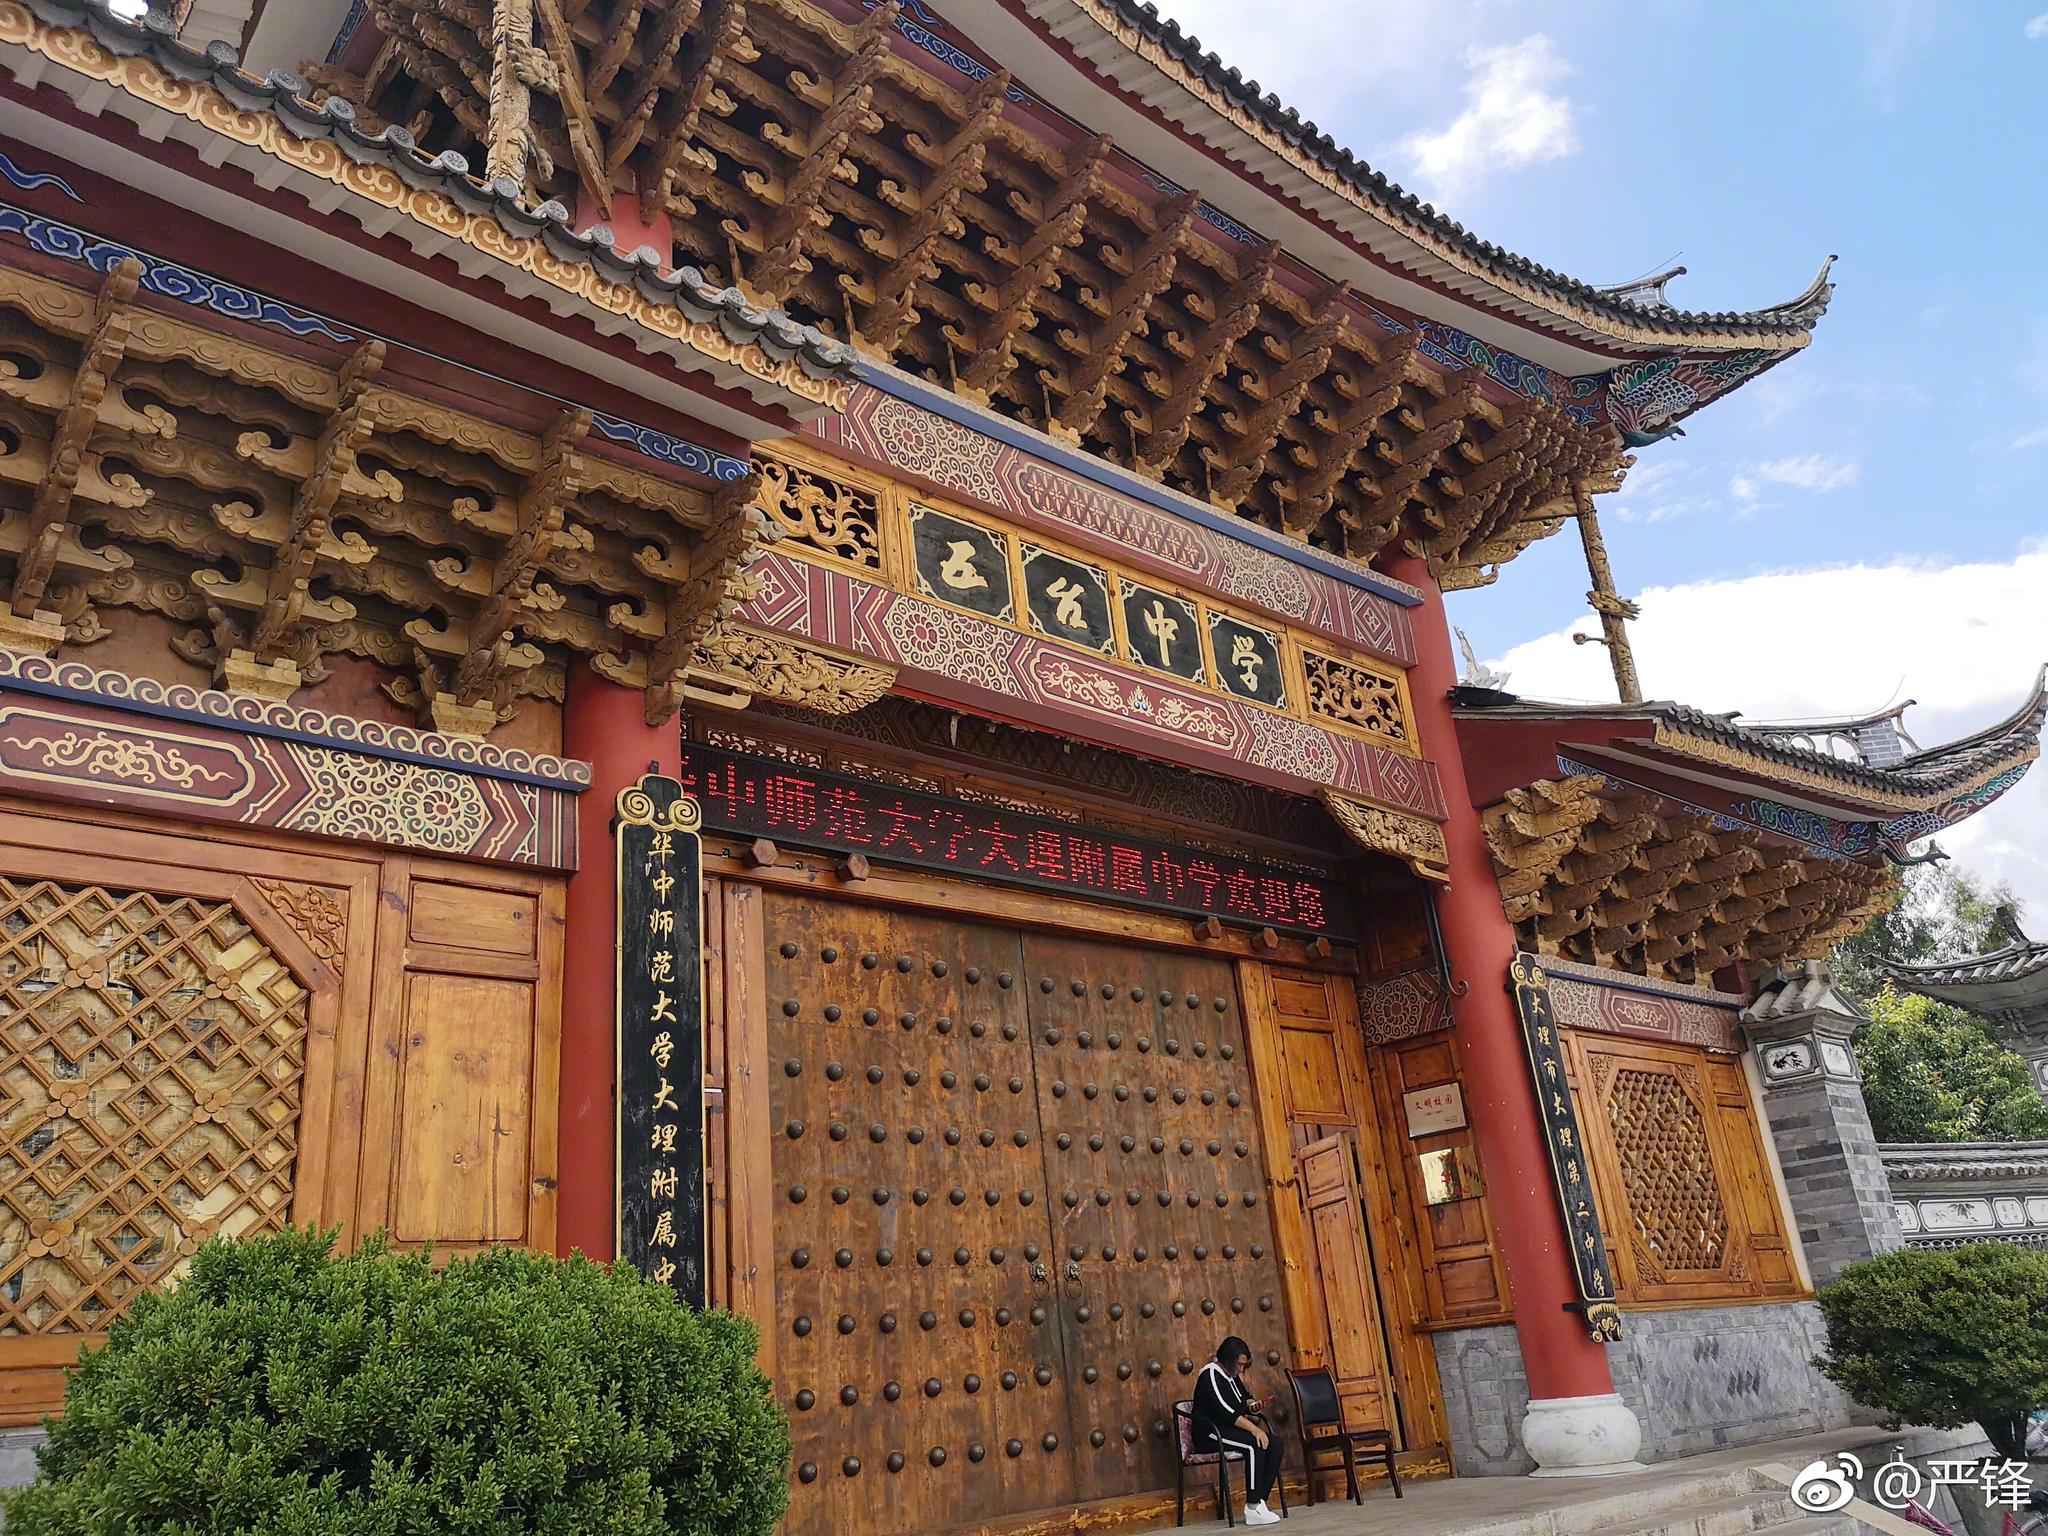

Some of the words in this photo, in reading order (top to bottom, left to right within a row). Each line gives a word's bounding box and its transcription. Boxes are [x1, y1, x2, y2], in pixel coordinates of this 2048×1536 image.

[1530, 990, 1605, 1298] 大理市大理第二中学
